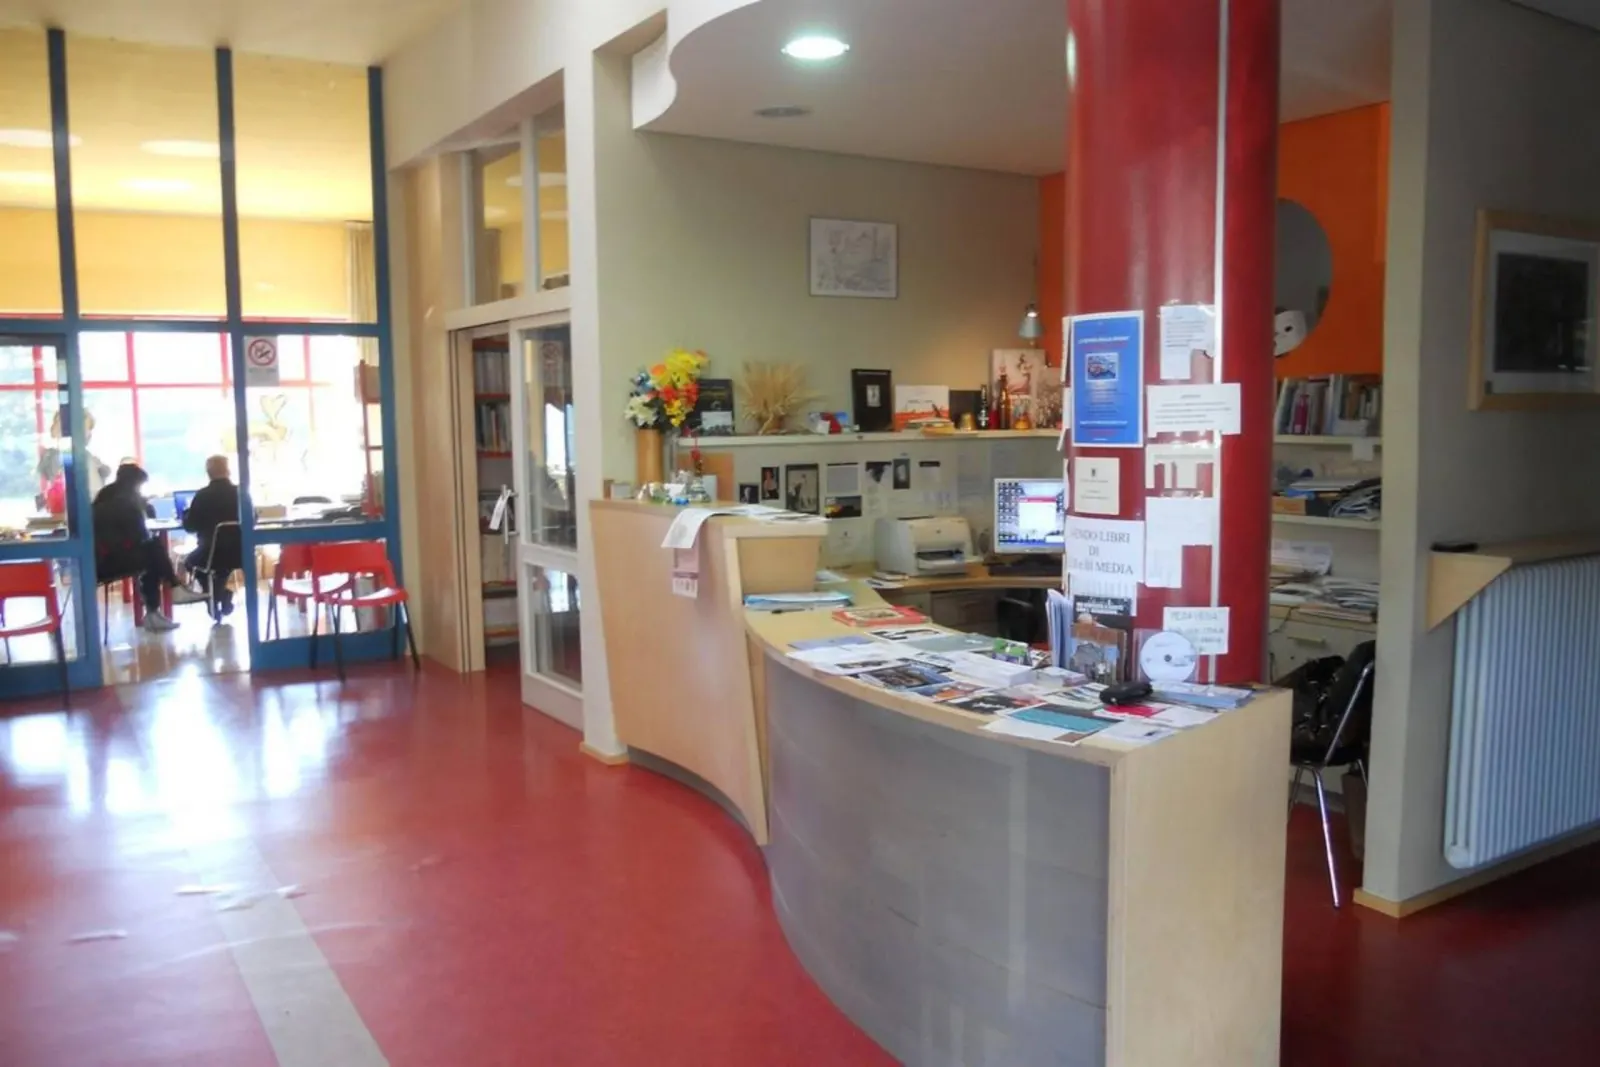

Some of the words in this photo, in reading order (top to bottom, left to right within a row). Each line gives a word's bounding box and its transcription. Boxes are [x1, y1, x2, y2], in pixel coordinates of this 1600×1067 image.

[1069, 528, 1098, 541] ENDO
[1100, 530, 1130, 544] LIBRI
[1088, 544, 1099, 556] DI
[1096, 561, 1134, 575] MEDIA
